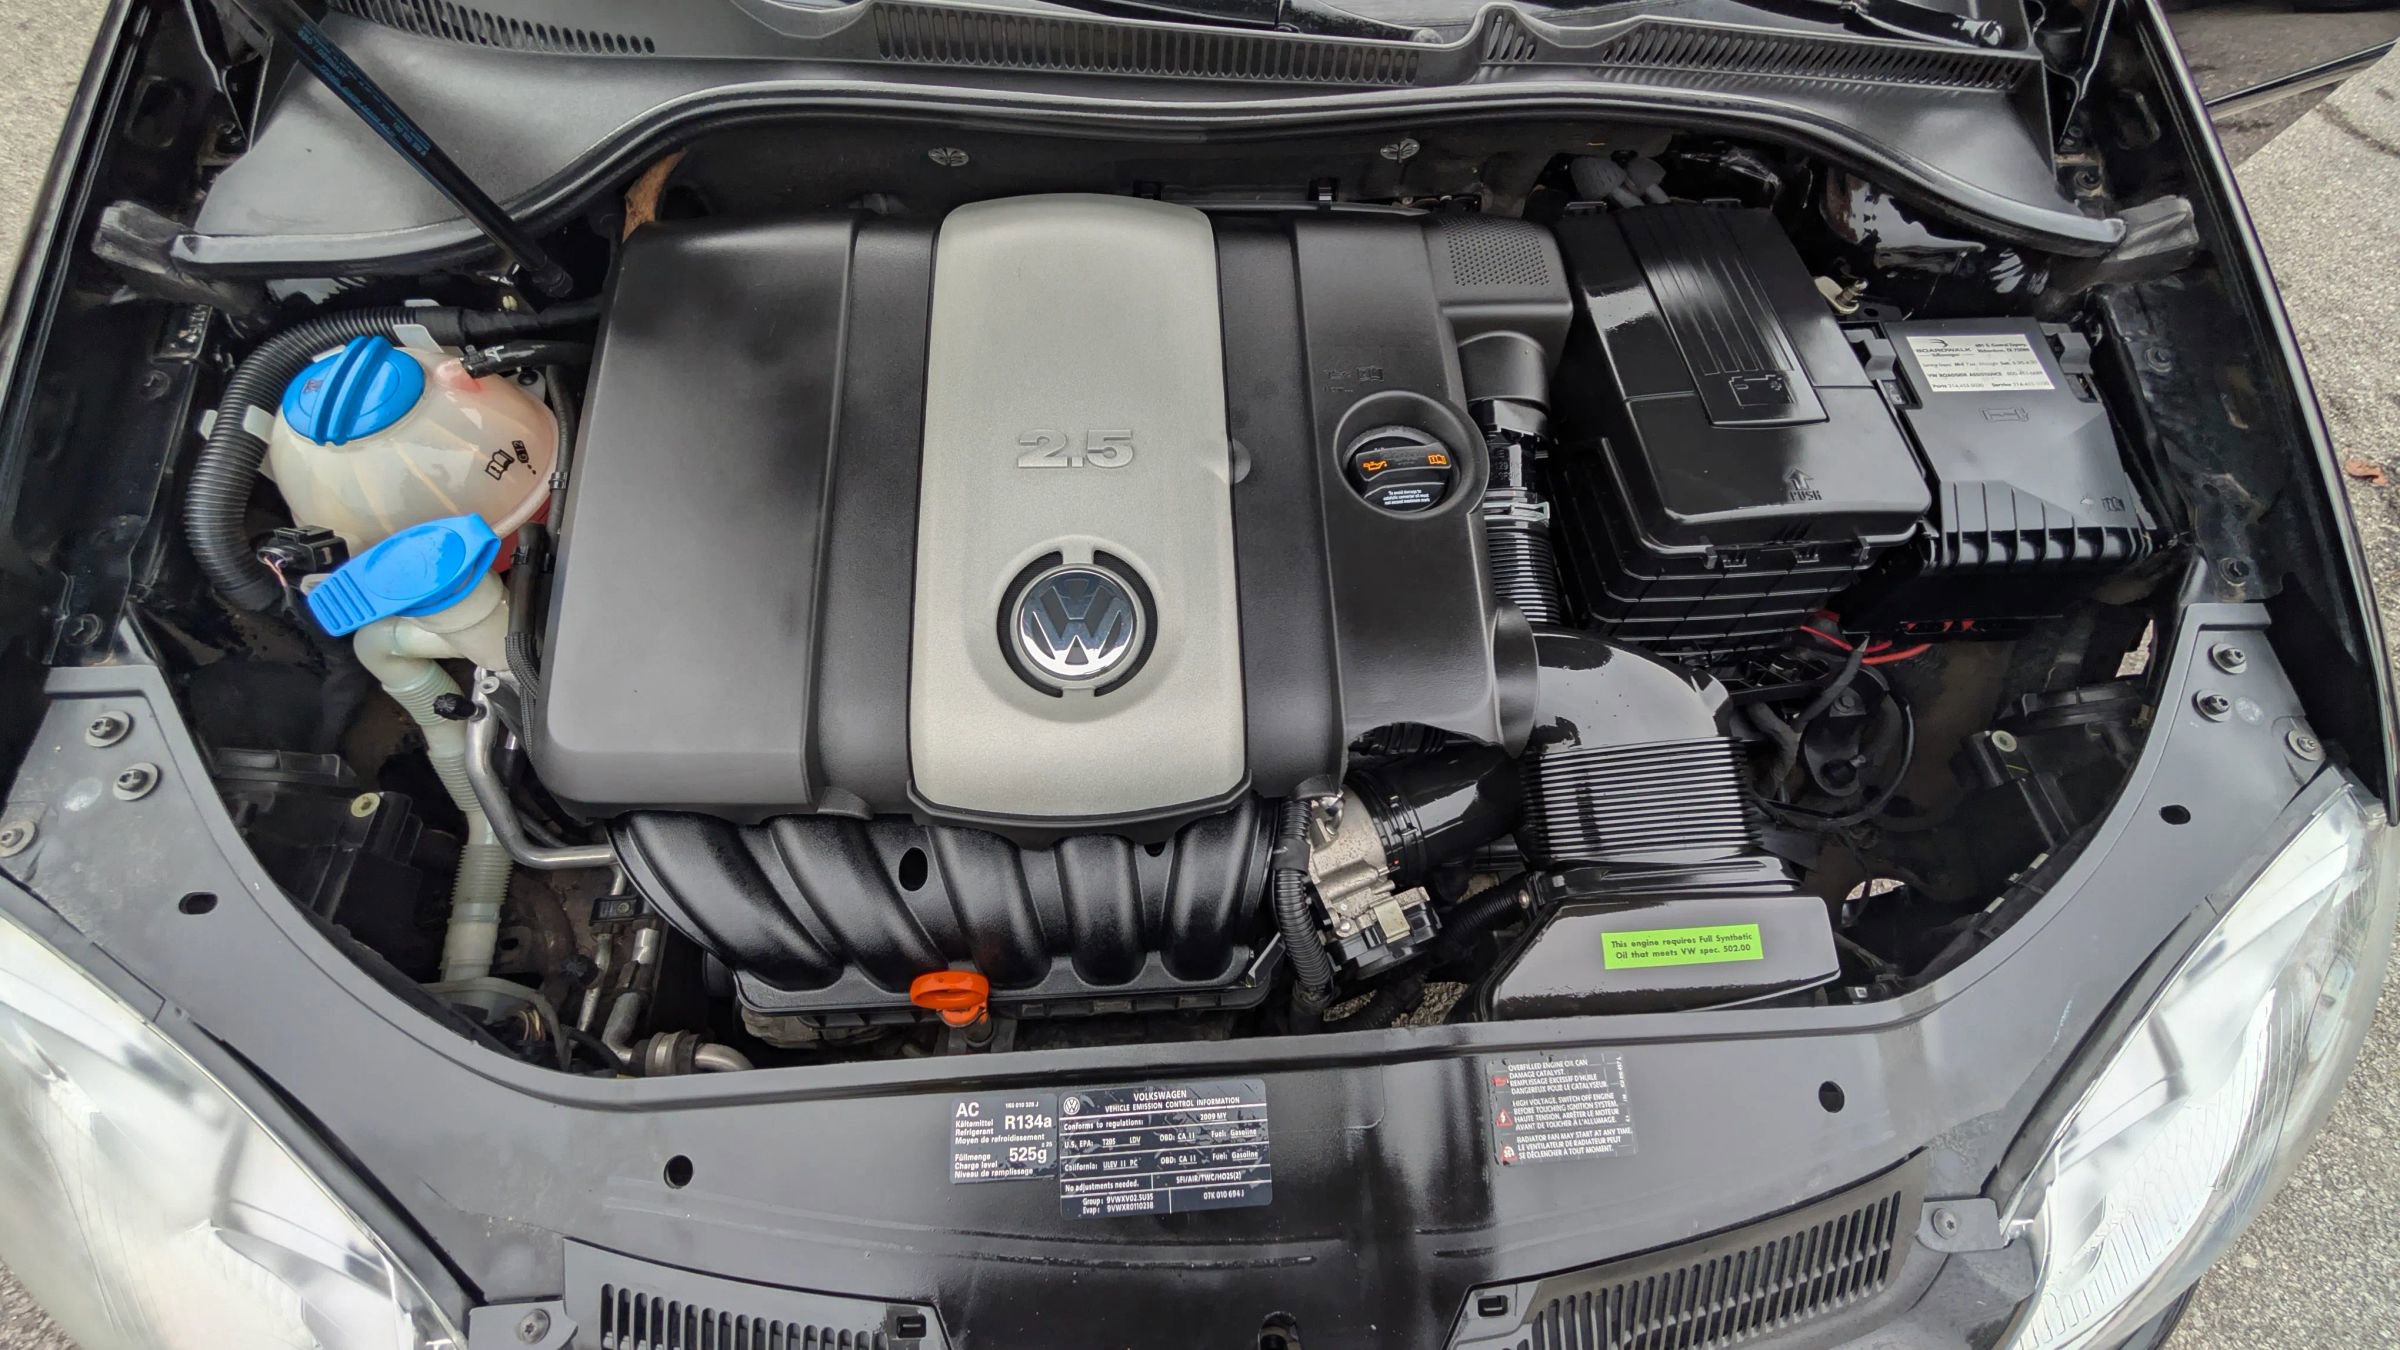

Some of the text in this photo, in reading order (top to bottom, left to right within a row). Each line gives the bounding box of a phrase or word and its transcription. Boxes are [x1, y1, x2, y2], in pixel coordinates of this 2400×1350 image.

[1017, 428, 1134, 468] 2.5
[1790, 490, 1822, 501] PUSH
[1611, 932, 1752, 949] This engine requires Full Synthetic
[1616, 944, 1750, 960] Oil that meets VW spec. 502.00
[1508, 1062, 1542, 1071] OVERFILLED
[1542, 1060, 1564, 1069] ENGINE
[1510, 1071, 1535, 1079] DAMAGE
[1510, 1078, 1548, 1087] REMPLISSAGE
[1549, 1075, 1573, 1084] EXCESSIF
[1511, 1085, 1546, 1095] DANGEREUX
[1547, 1084, 1563, 1092] POUR
[1133, 1090, 1187, 1102] VOLKSWAGEN
[956, 1102, 980, 1118] AC
[1105, 1096, 1240, 1113] VEHICLE EMISSION CONTROL INFORMATION
[1514, 1100, 1619, 1115] BEFORE TOUCHING IGNITION SYSTEM.
[1514, 1115, 1534, 1123] HAUTE
[1594, 1108, 1620, 1116] MOTEUR
[955, 1119, 994, 1128] Kältemittel
[1005, 1114, 1052, 1130] R134a
[1064, 1122, 1094, 1131] Conforms
[1106, 1118, 1144, 1129] regulations:
[1546, 1119, 1572, 1128] TOUCHER
[1573, 1117, 1578, 1126] À
[1579, 1116, 1616, 1126] L'ALLUMAGE.
[955, 1128, 994, 1137] Refrigerant
[1516, 1134, 1546, 1144] RADIATOR
[1560, 1131, 1574, 1139] MAY
[1576, 1130, 1592, 1138] START
[1616, 1127, 1633, 1135] TIME.
[955, 1137, 979, 1145] Moyen
[992, 1134, 1045, 1142] refroidissement
[1079, 1140, 1094, 1148] EPA:
[1526, 1141, 1564, 1150] VENTILATEUR
[1565, 1139, 1573, 1147] DE
[1573, 1137, 1606, 1146] RADIATEUR
[1607, 1135, 1621, 1144] PEUT
[955, 1153, 991, 1161] Füllmenge
[1009, 1146, 1047, 1164] 525g
[1519, 1144, 1615, 1160] SE DÉCLENCHER À TOUT MOMENT.
[955, 1162, 979, 1170] Charge
[1064, 1163, 1098, 1172] California:
[1103, 1161, 1118, 1169] ULEV
[1231, 1151, 1258, 1159] Gasoline
[954, 1170, 979, 1178] Niveau
[992, 1168, 1033, 1177] remplissage
[1065, 1179, 1139, 1192] No adjustments needed.
[1203, 1191, 1215, 1200] 07K
[1216, 1190, 1227, 1199] 010
[1082, 1206, 1100, 1215] Evap:
